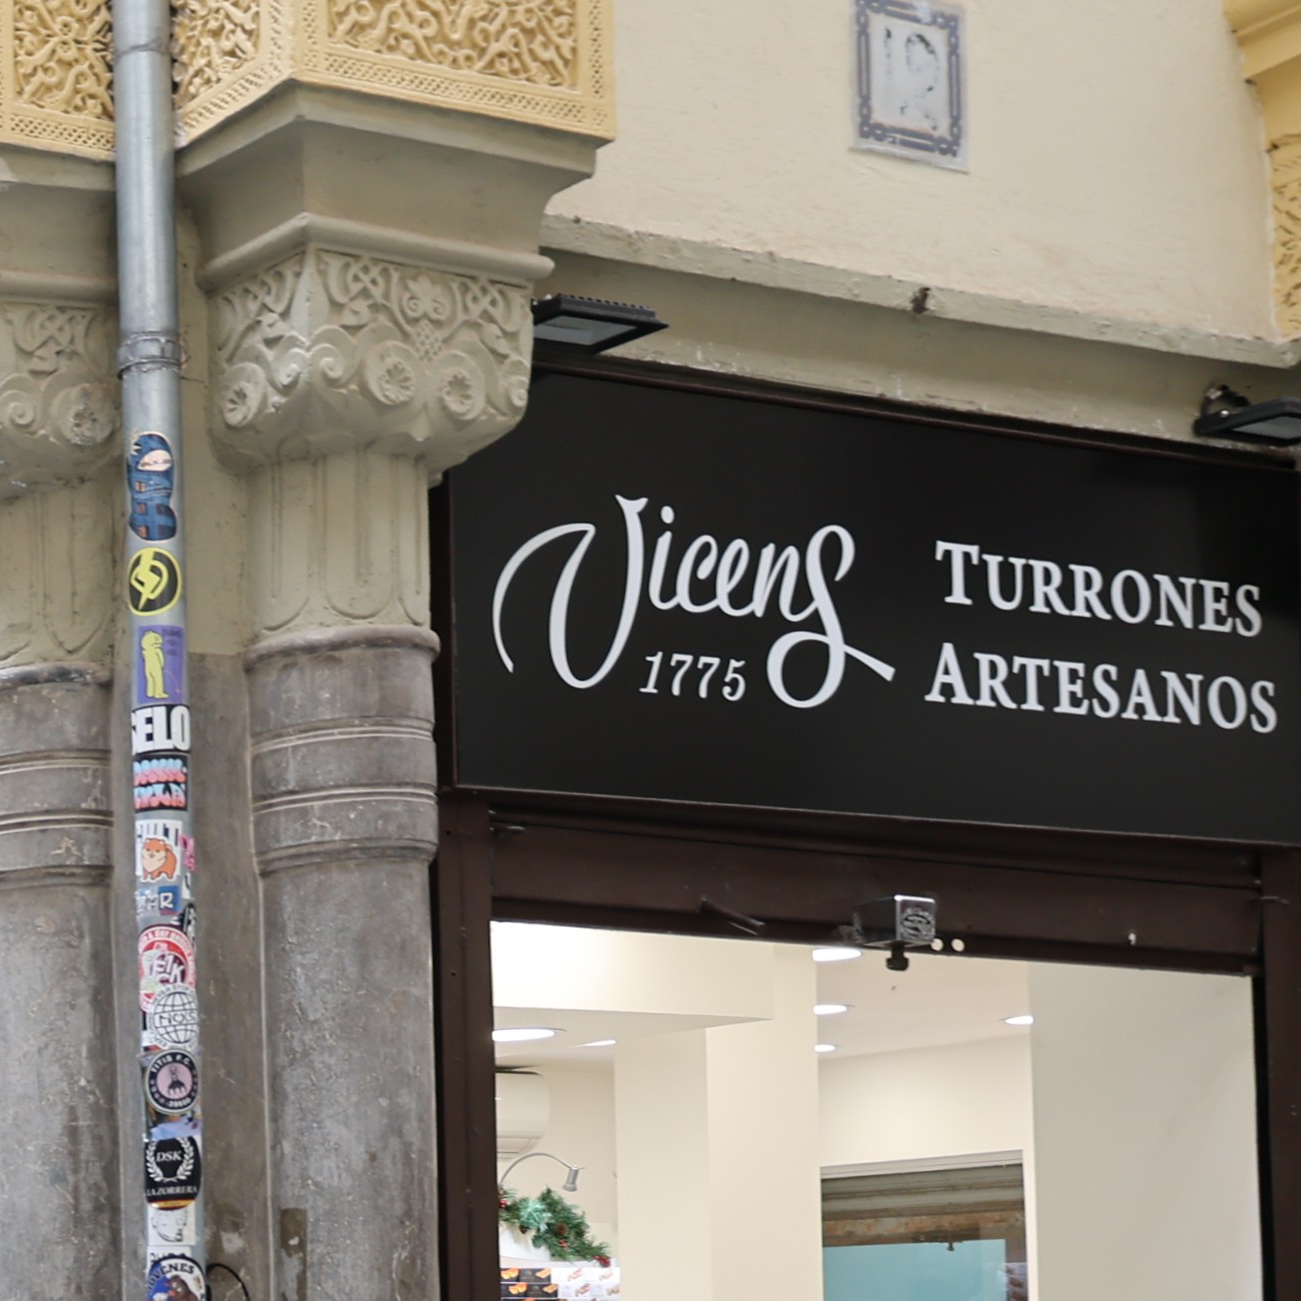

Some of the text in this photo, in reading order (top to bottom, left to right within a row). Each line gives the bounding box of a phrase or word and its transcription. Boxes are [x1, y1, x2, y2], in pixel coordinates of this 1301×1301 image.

[492, 494, 896, 708] Vicens
[935, 540, 1263, 637] TURRONES
[639, 651, 747, 702] 1775
[924, 643, 1278, 733] ARTESANOS
[156, 1152, 183, 1163] DSK
